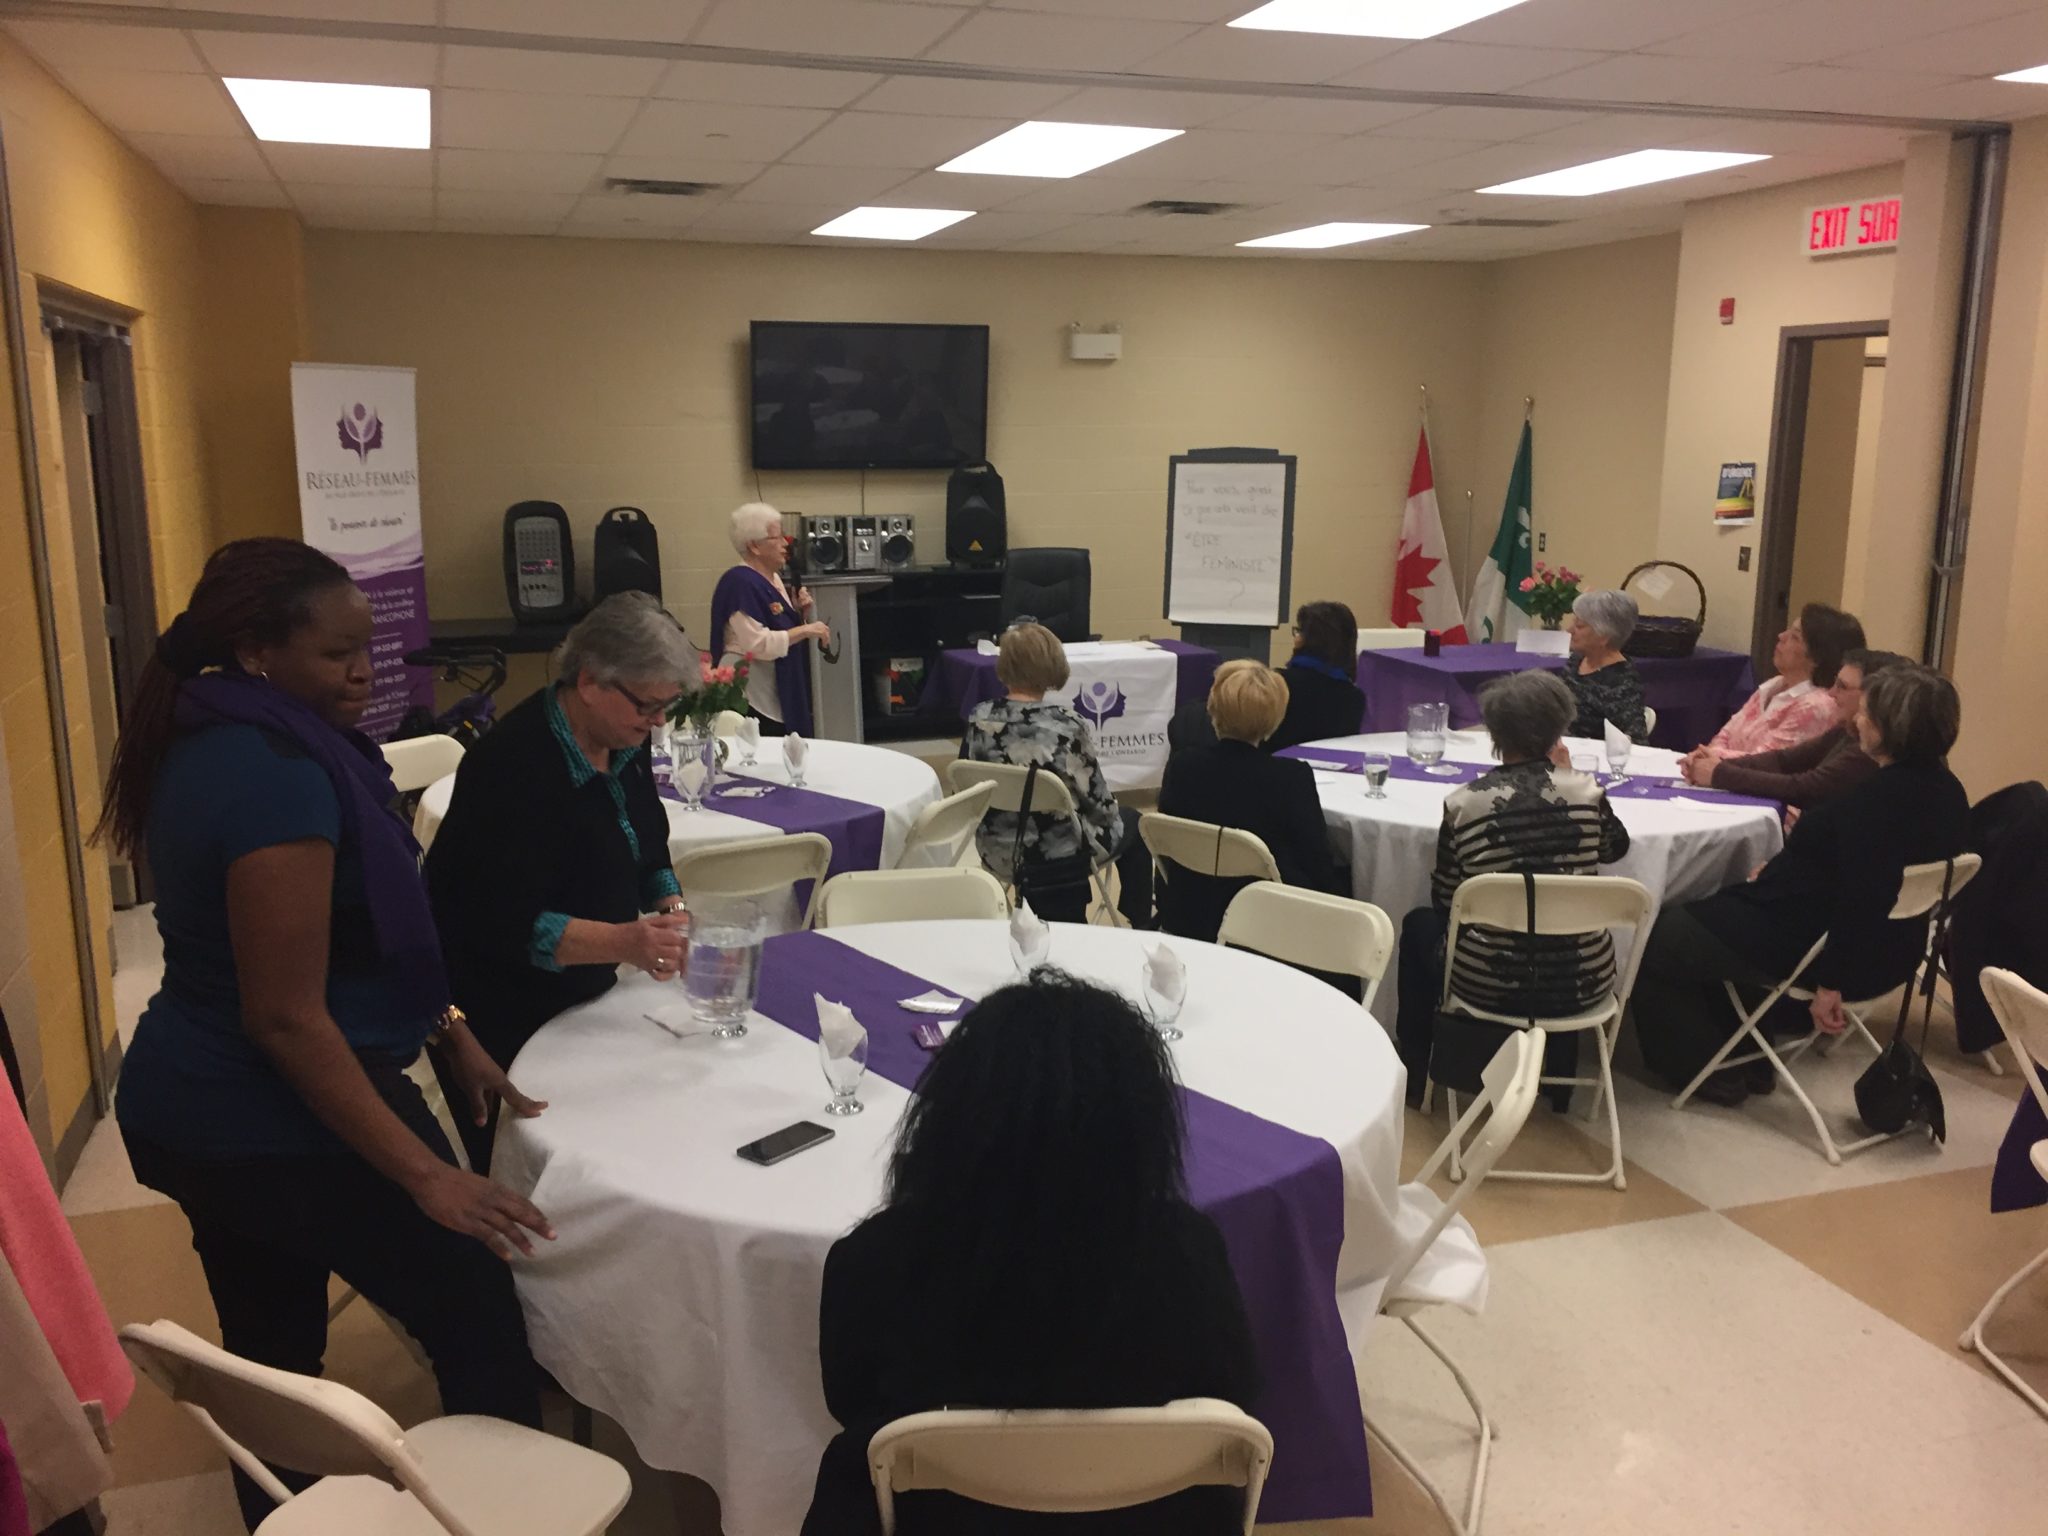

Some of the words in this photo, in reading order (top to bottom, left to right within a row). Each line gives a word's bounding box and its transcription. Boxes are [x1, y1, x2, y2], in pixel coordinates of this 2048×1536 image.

[1810, 206, 1850, 250] EXIT
[1858, 199, 1900, 244] SOR
[1093, 732, 1165, 748] -FEMMES
